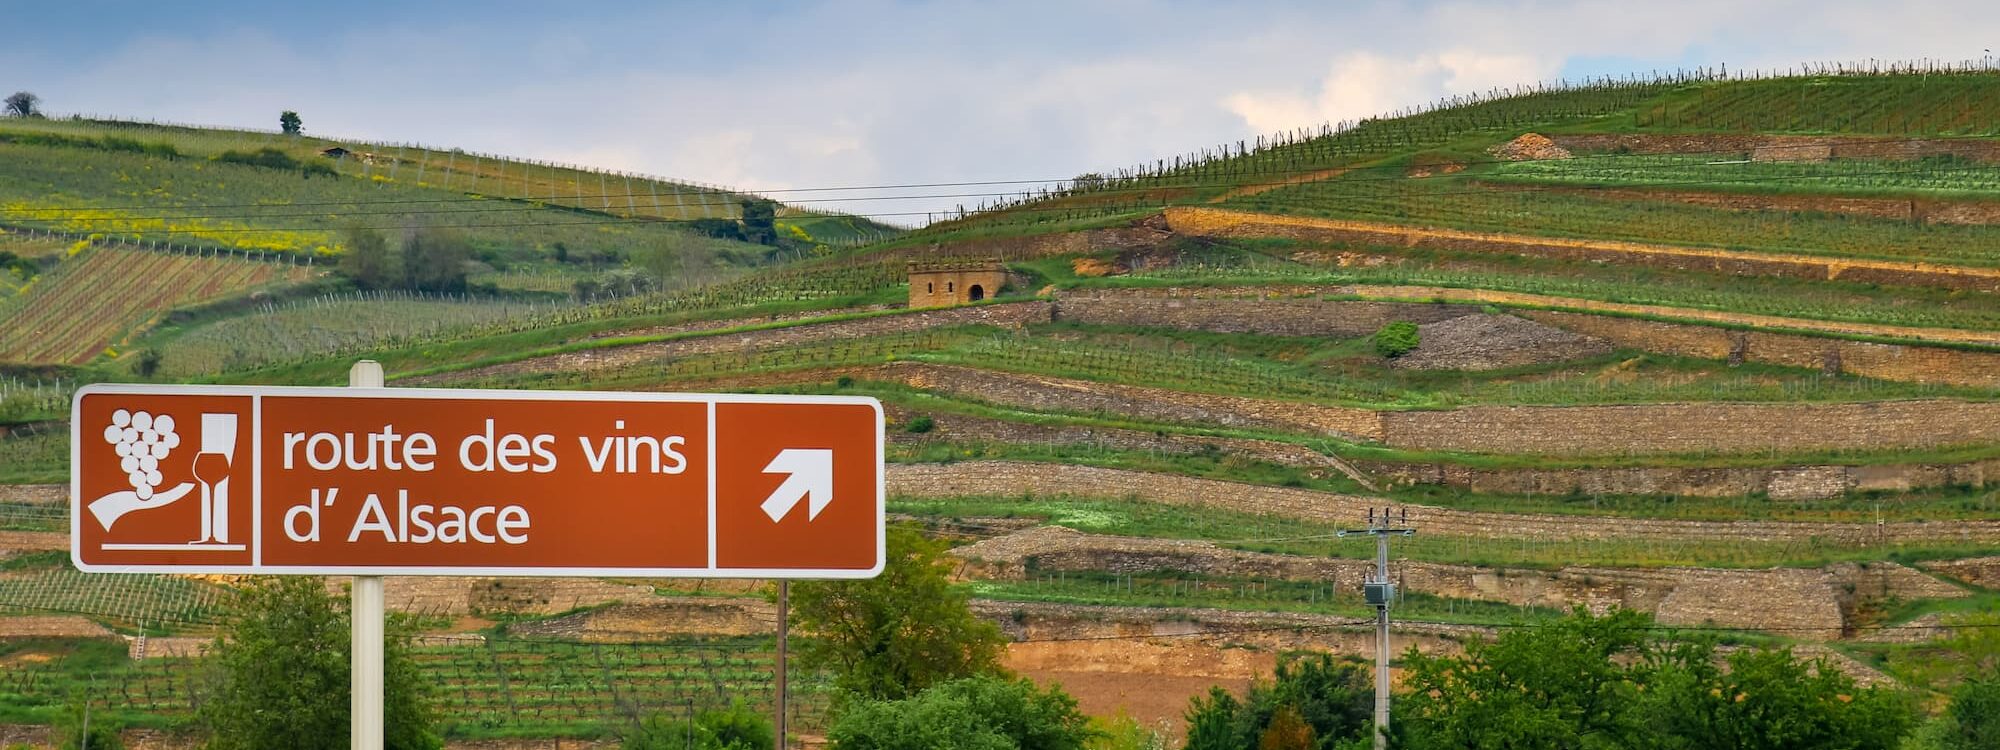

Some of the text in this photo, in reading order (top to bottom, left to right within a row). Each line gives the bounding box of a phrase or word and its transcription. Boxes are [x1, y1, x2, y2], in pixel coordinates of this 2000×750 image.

[283, 418, 687, 475] route des vins
[347, 489, 531, 544] Alsace
